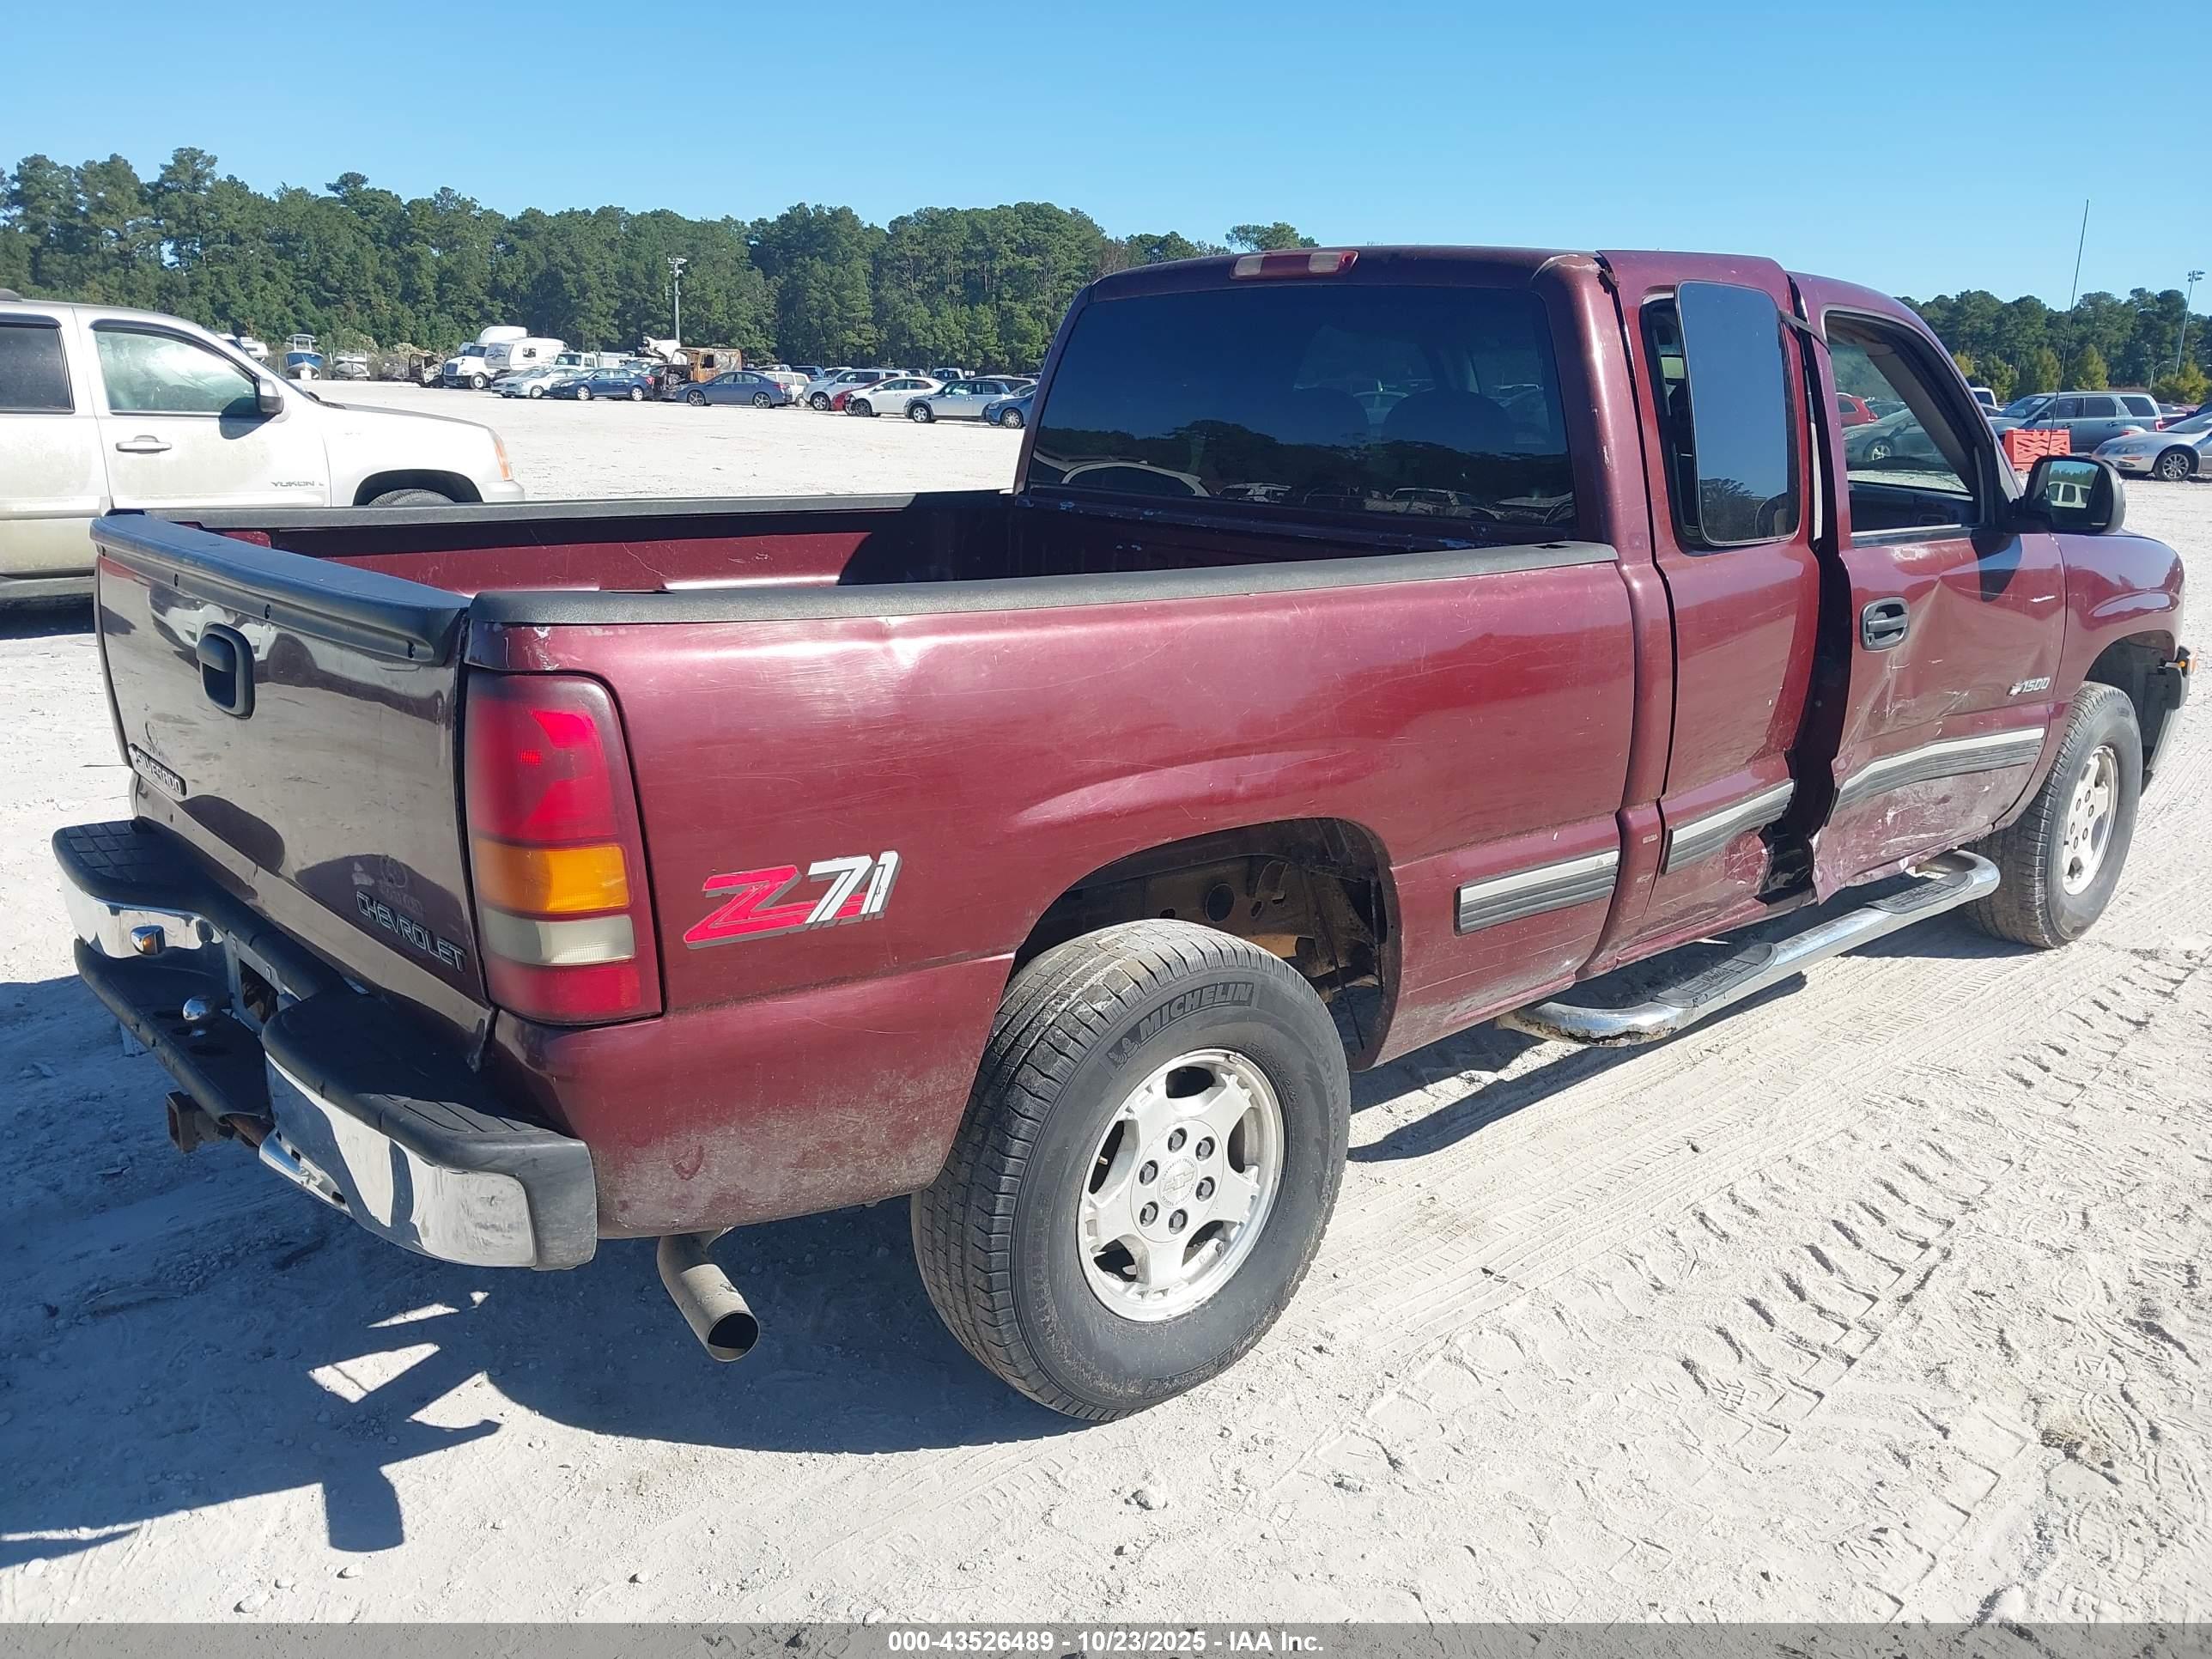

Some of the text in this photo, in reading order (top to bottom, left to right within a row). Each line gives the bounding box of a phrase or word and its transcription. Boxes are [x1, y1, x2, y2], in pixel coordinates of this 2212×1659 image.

[2021, 676, 2051, 694] 1500
[135, 749, 183, 795] SILVERADO
[684, 849, 902, 951] Z71
[356, 890, 466, 973] CHEVROLET
[1138, 982, 1253, 1042] MICHELIN
